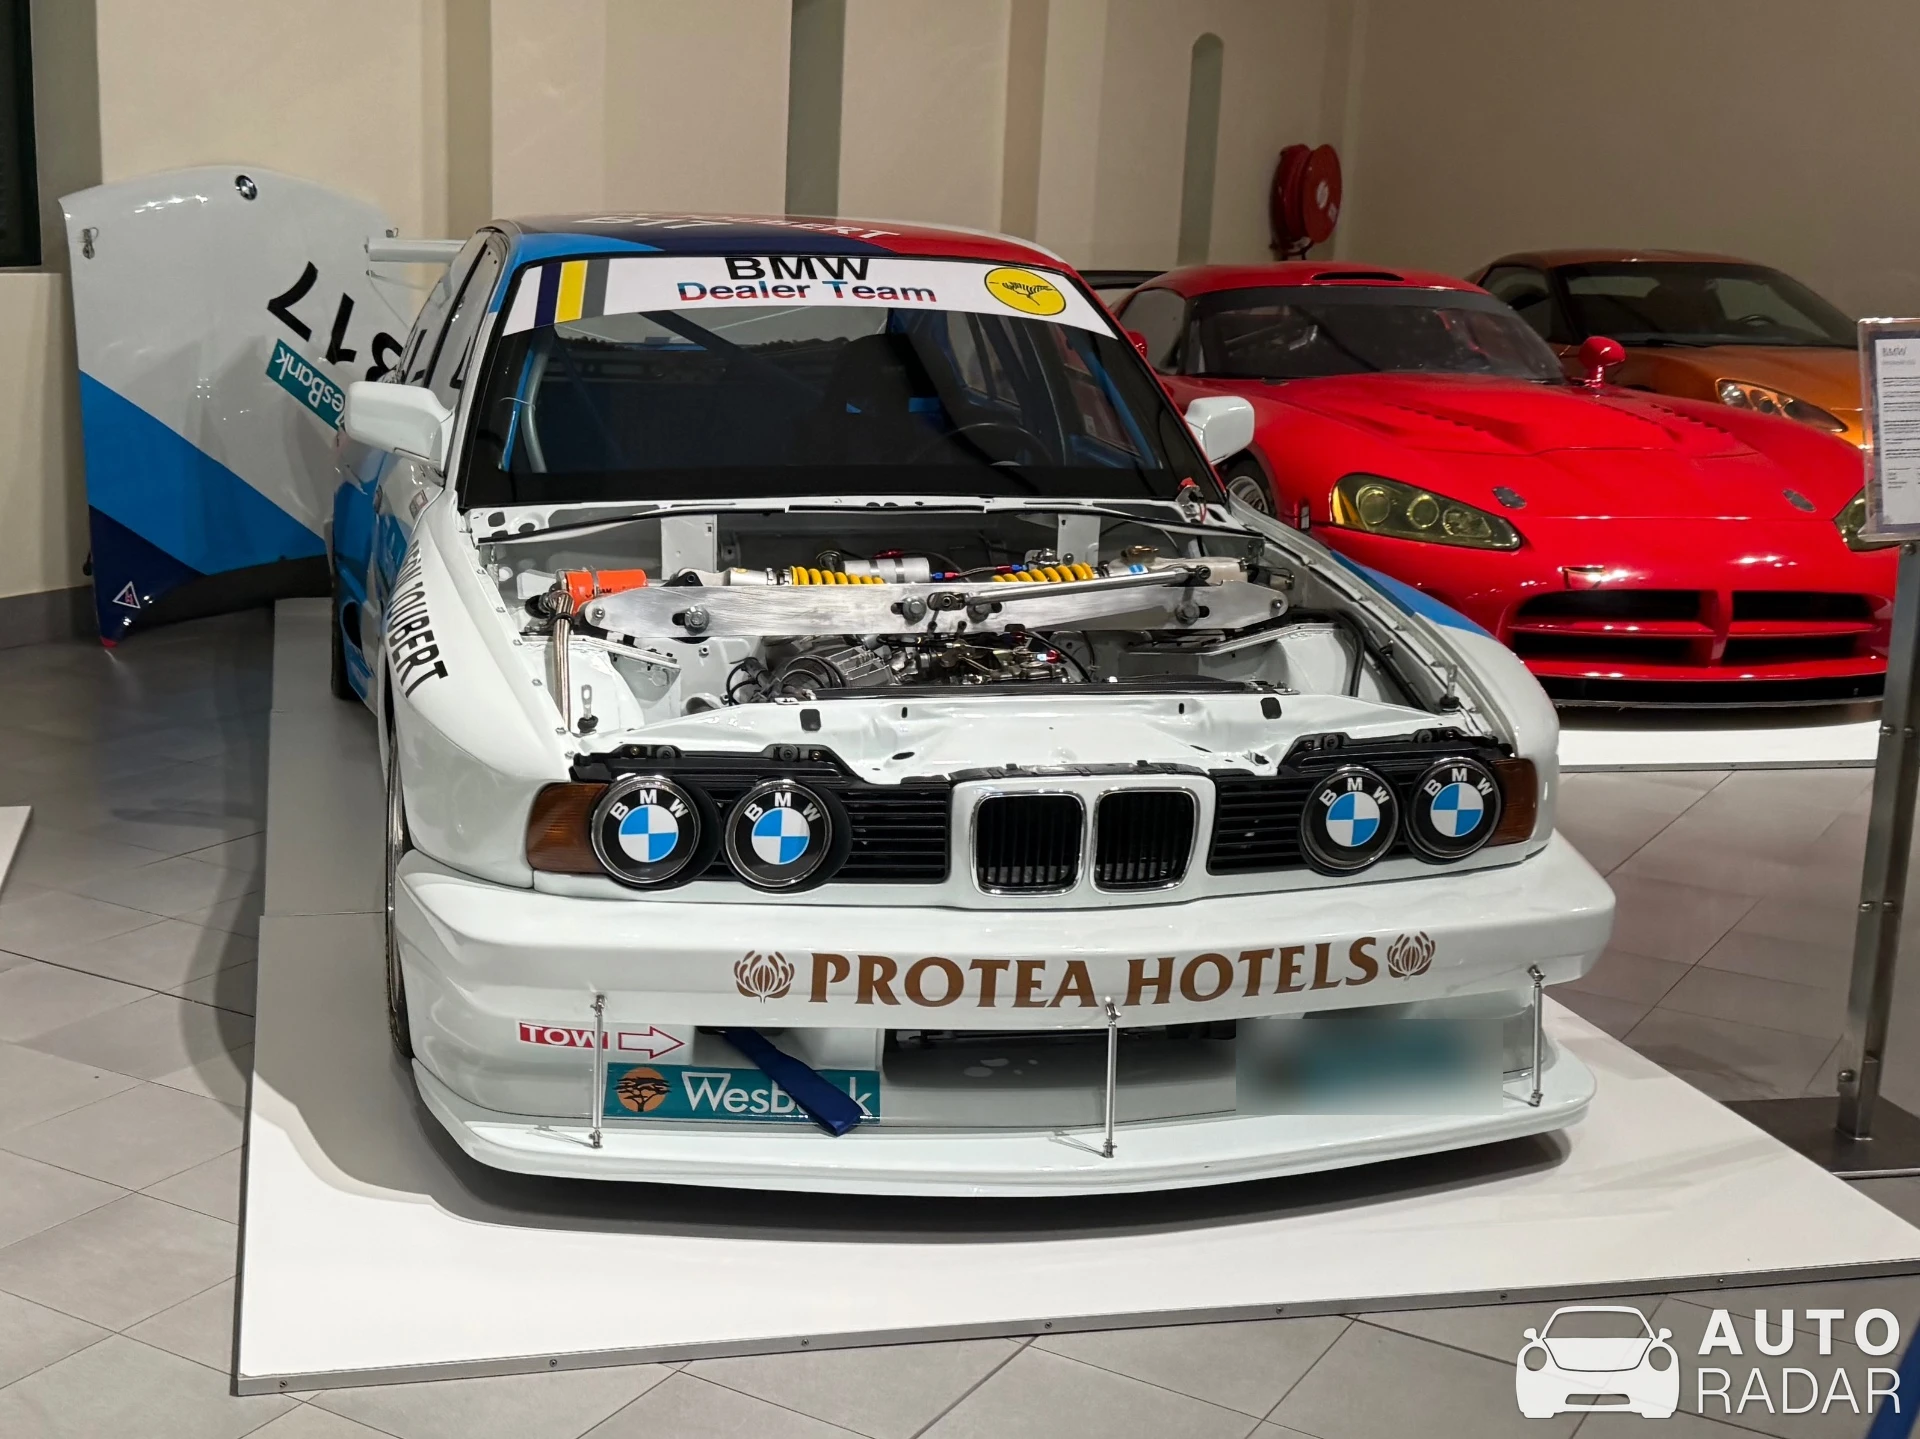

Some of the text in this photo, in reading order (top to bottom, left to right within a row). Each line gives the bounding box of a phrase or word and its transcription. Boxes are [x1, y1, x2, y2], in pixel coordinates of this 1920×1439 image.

[725, 256, 869, 280] BMW
[677, 281, 937, 302] Dealer Team
[385, 580, 449, 698] JOUBERT
[1319, 777, 1390, 807] BMW
[1424, 768, 1493, 797] BMW
[610, 789, 689, 821] BMW
[744, 791, 821, 822] BMW
[808, 936, 1379, 1008] PROTEA HOTELS
[519, 1024, 606, 1049] TOW
